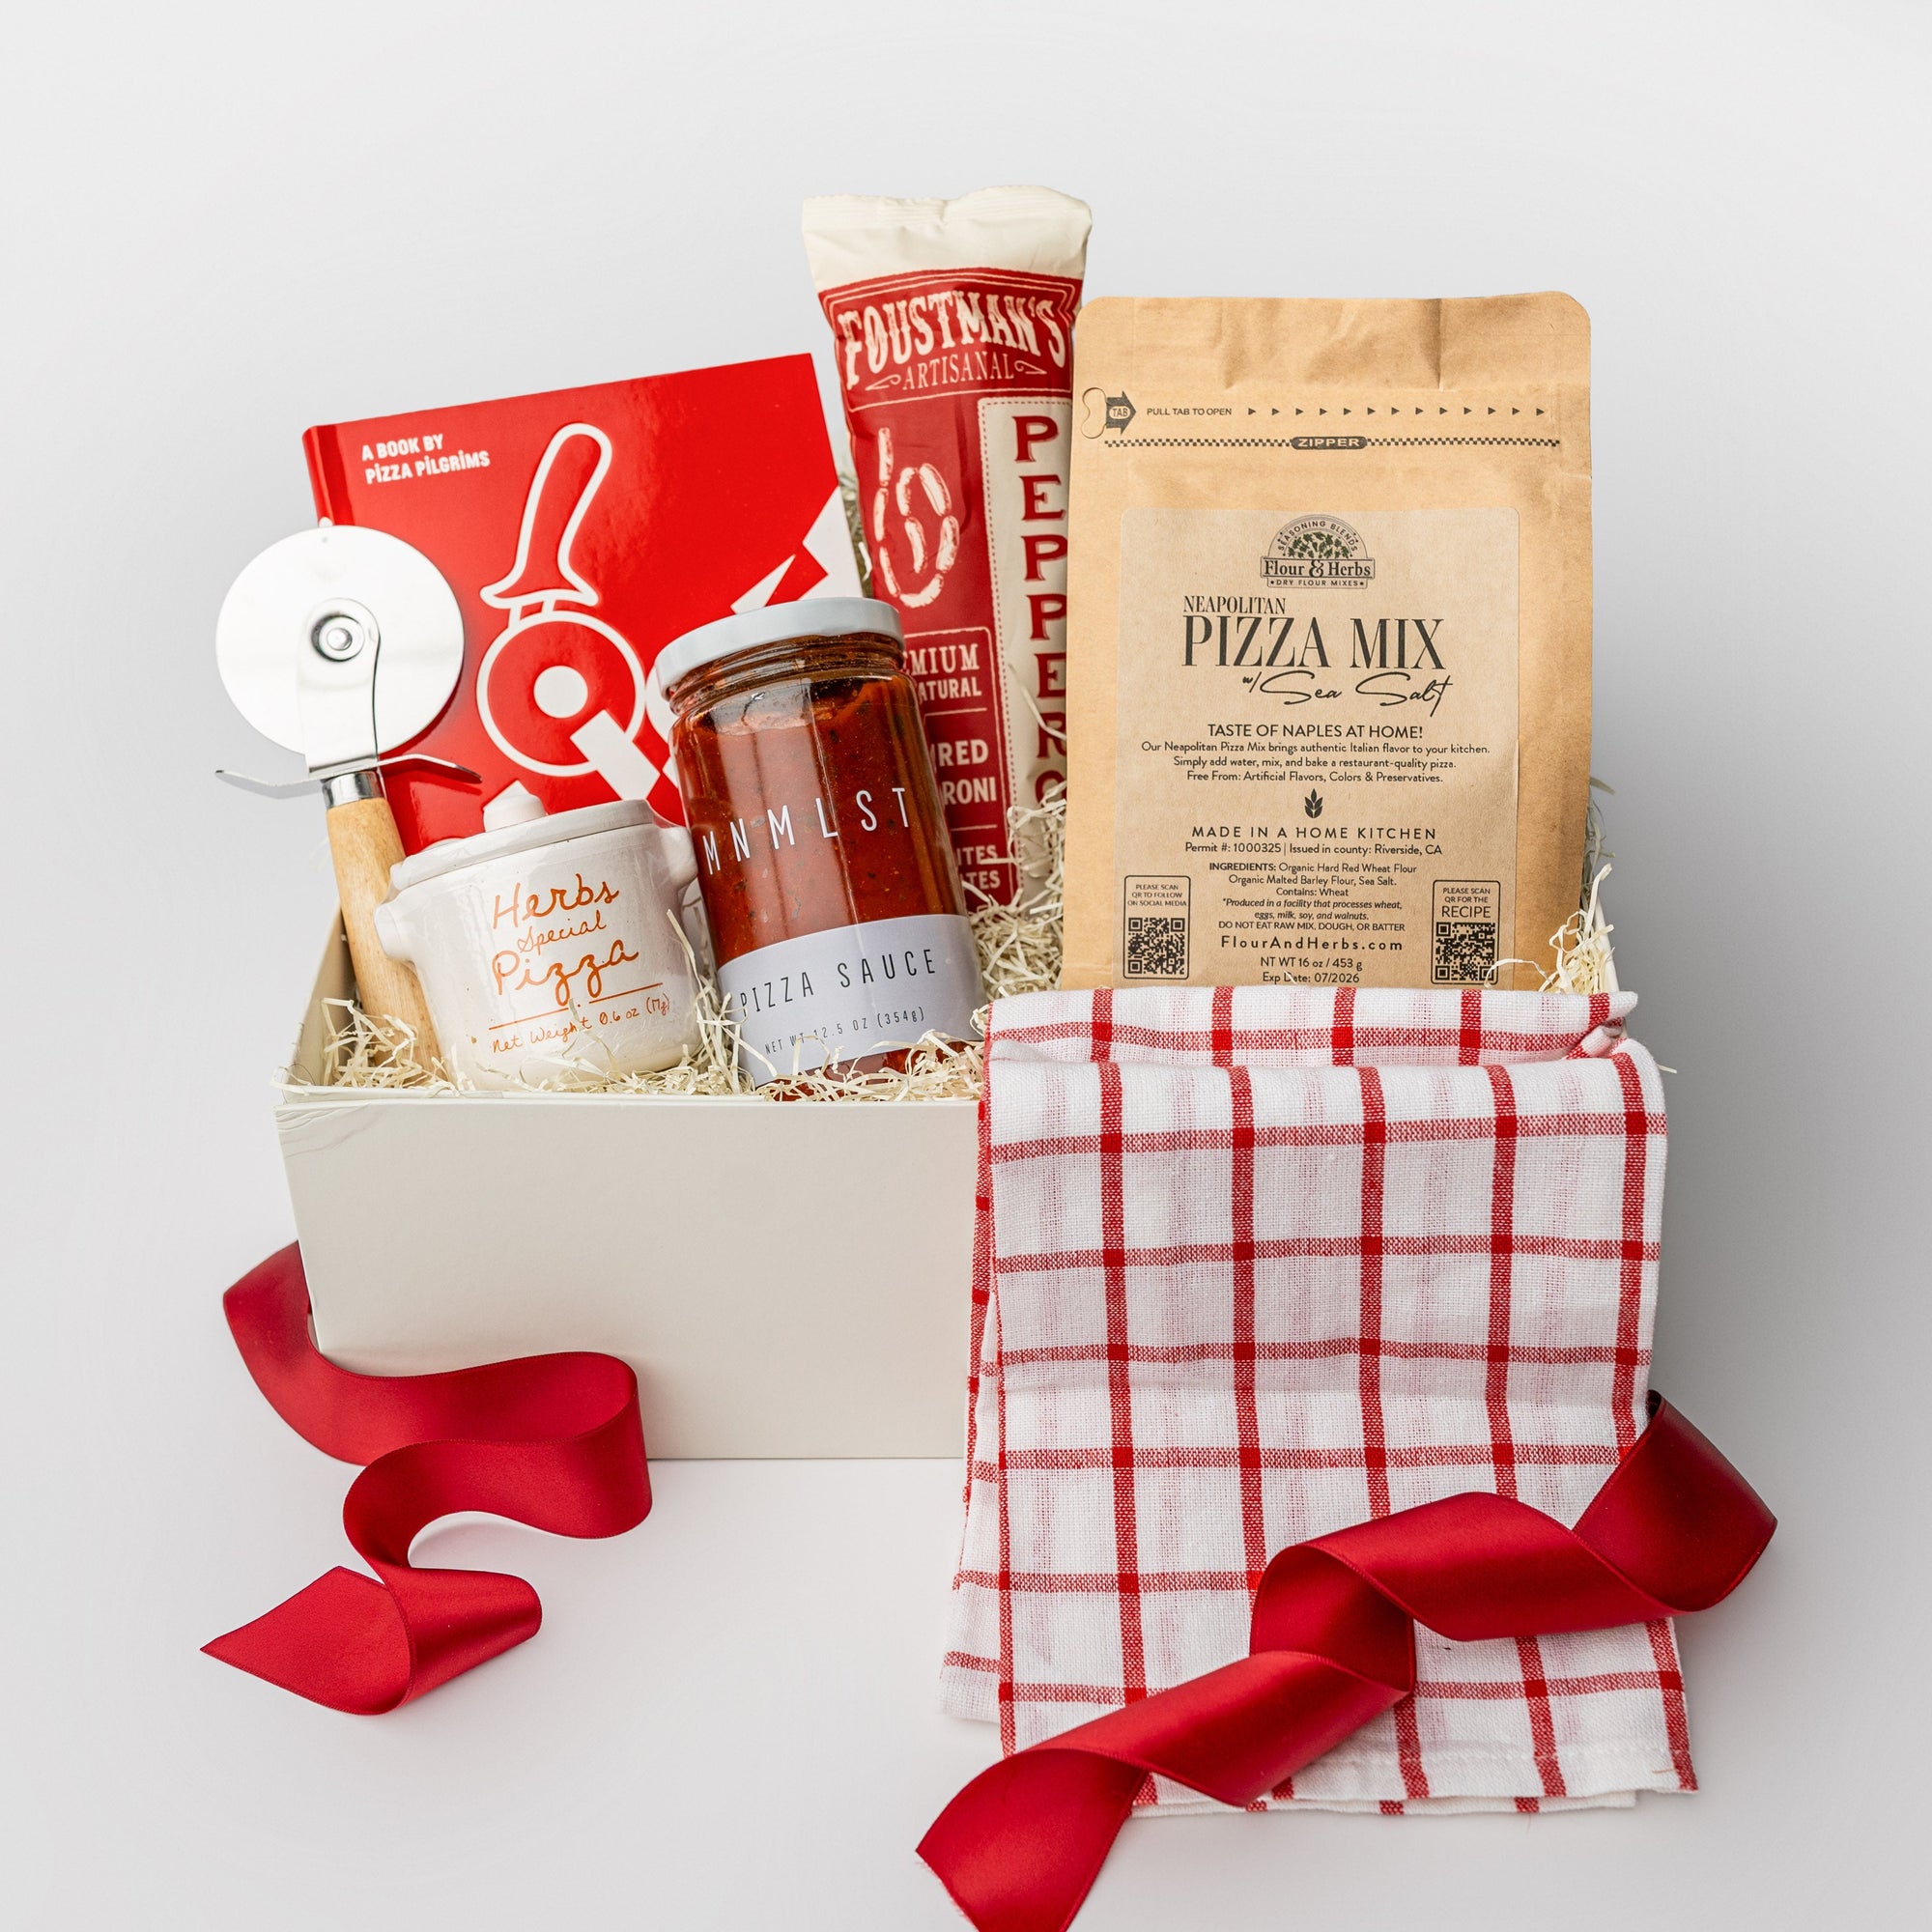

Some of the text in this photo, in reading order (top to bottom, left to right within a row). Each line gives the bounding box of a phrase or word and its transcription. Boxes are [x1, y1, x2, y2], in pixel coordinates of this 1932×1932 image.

[838, 290, 1065, 390] FOUSTMAN'S
[902, 351, 1015, 390] ARTISANAL
[1112, 408, 1128, 417] TAB
[1147, 408, 1232, 416] PULL TAB TO OPEN
[362, 433, 443, 462] A BOOK BY
[1297, 438, 1360, 448] ZIPPER
[1278, 520, 1358, 552] SEASONING BLENDS
[1264, 559, 1371, 578] Flour & Herbs
[1183, 595, 1287, 615] NEAPOLITAN
[1181, 614, 1446, 669] PIZZA MIX
[903, 642, 980, 676] MIUM
[918, 676, 982, 702] ATURAL
[1260, 670, 1343, 705] Sea
[1355, 671, 1454, 717] Salt
[1208, 724, 1423, 738] TASTE OF NAPLES AT HOME!
[1142, 741, 1491, 756] Our Neapolitan Pizza Mix brings authentic Italian flavor to your kitchen.
[1174, 756, 1208, 769] Simply
[1209, 756, 1227, 766] add
[1230, 758, 1259, 768] water,
[1262, 757, 1283, 768] mix,
[1285, 756, 1303, 767] and
[1305, 757, 1328, 767] bake
[1339, 758, 1428, 771] restaurant-quality
[1431, 759, 1457, 770] pizza.
[1187, 770, 1443, 782] Free From: Artificial Flavors, Colors & Preservatives.
[940, 777, 997, 806] RONI
[703, 787, 909, 875] MNMLST
[1192, 826, 1435, 839] MADE IN A HOME KITCHEN
[1185, 841, 1217, 852] Permit
[1234, 842, 1282, 853] 1000325
[1290, 843, 1320, 853] Issued
[1321, 843, 1331, 854] in
[1333, 845, 1372, 857] county:
[1375, 843, 1423, 856] Riverside,
[1425, 844, 1442, 855] CA
[1209, 862, 1417, 874] INGREDIENTS: Organic Hard Red Wheat Flour
[1228, 873, 1397, 888] Organic Malted Barley Flour, Sea Salt.
[1276, 887, 1349, 896] Contains: Wheat
[493, 873, 620, 929] Herbs
[1266, 898, 1274, 907] in
[1283, 898, 1312, 909] facility
[1314, 899, 1331, 908] that
[1333, 901, 1373, 910] processes
[1374, 900, 1403, 910] wheat,
[1254, 912, 1275, 922] eggs,
[1277, 911, 1295, 920] milk,
[1299, 913, 1314, 922] soy,
[1334, 912, 1369, 921] walnuts.
[1441, 905, 1492, 919] RECIPE
[517, 909, 607, 956] Special
[1218, 921, 1234, 929] DO
[1235, 921, 1255, 929] NOT
[1274, 922, 1295, 930] RAW
[1319, 923, 1354, 931] DOUGH,
[1356, 923, 1371, 931] OR
[1221, 935, 1403, 951] FlourAndHerbs.com
[1261, 956, 1276, 967] NT
[1278, 957, 1296, 967] WT
[1298, 957, 1310, 967] 16
[1332, 957, 1353, 968] 453
[1356, 961, 1363, 972] g
[492, 939, 639, 1007] Pizza
[1263, 971, 1281, 984] Exp
[1314, 972, 1360, 983] 07/2026
[740, 949, 936, 1016] PIZZA SAUCE
[493, 1037, 523, 1053] Net
[531, 1017, 592, 1043] Weight
[599, 1011, 621, 1026] 0.6
[625, 1008, 640, 1019] oz
[764, 1006, 924, 1055] NET WT 12.5 OZ (354g)
